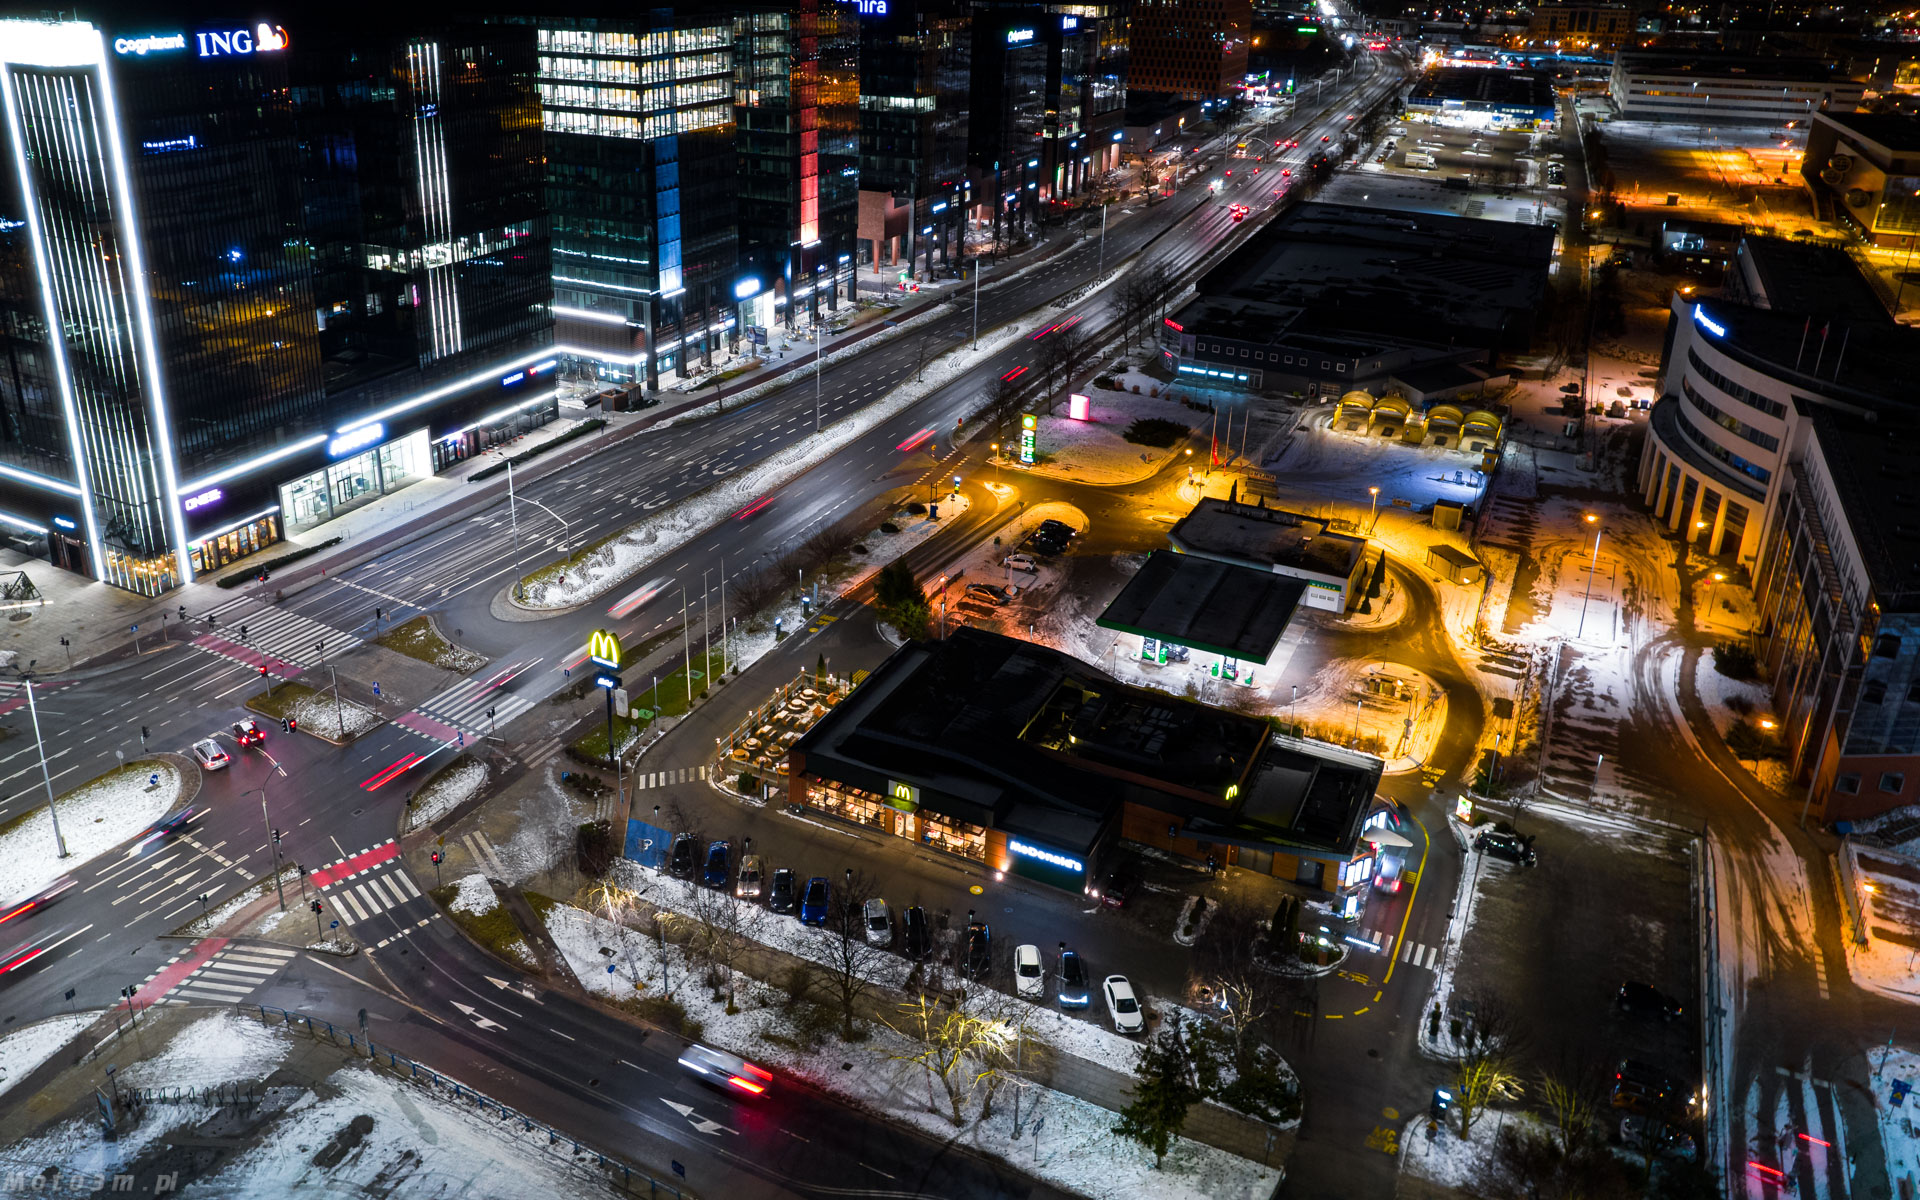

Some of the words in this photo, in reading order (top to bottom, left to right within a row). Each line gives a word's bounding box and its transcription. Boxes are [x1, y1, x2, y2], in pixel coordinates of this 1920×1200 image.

[114, 33, 185, 55] Cognizant
[197, 30, 253, 56] ING
[1009, 840, 1083, 873] McDonald's
